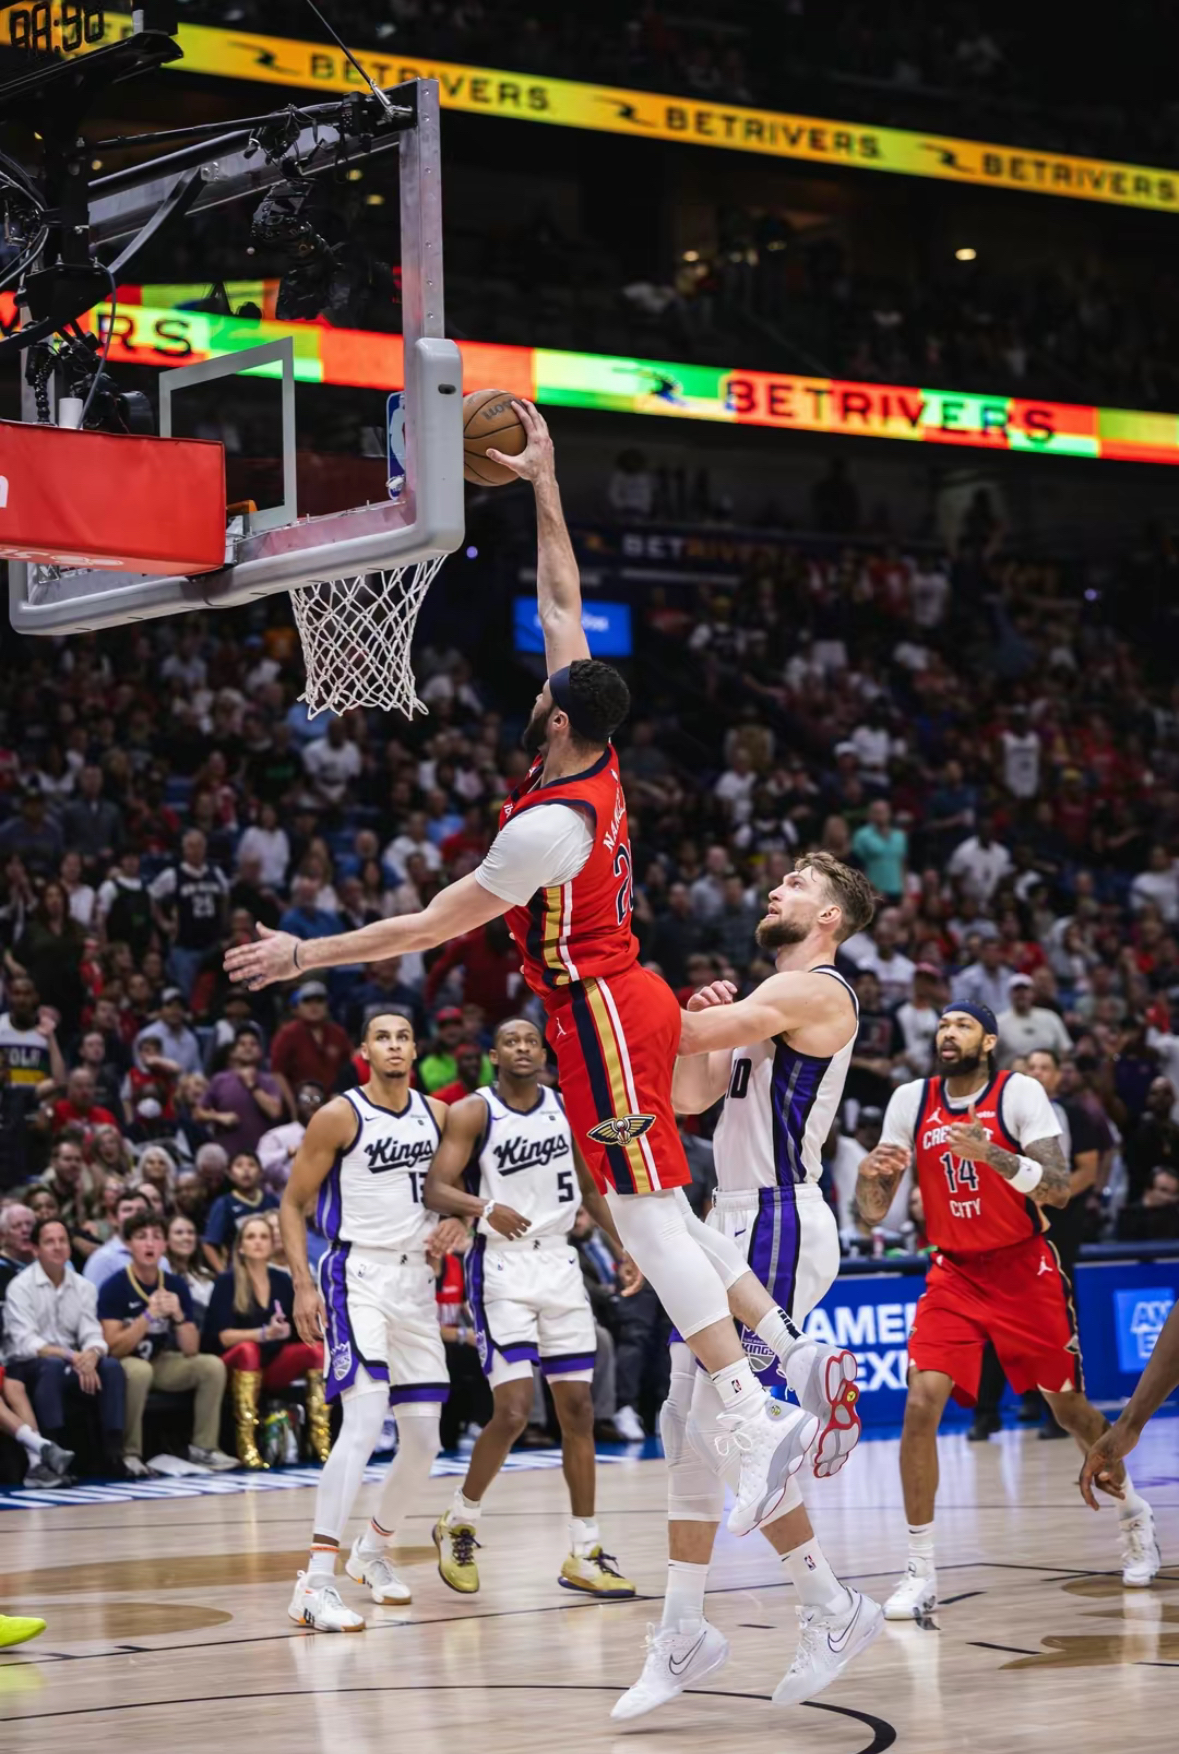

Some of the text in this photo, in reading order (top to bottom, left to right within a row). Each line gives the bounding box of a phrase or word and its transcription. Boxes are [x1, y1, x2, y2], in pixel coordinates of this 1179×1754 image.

[310, 52, 550, 111] BETRVERS
[665, 106, 880, 158] BETRIVERS
[982, 152, 1176, 203] BETRIVERS
[725, 379, 1056, 444] BETRIVERS
[613, 838, 633, 926] 2
[726, 1057, 752, 1099] 0
[364, 1137, 433, 1174] Kings
[493, 1134, 569, 1176] Kings
[923, 1125, 994, 1150] CRET
[557, 1171, 574, 1203] 5
[940, 1151, 979, 1193] 14
[950, 1198, 981, 1218] CITY
